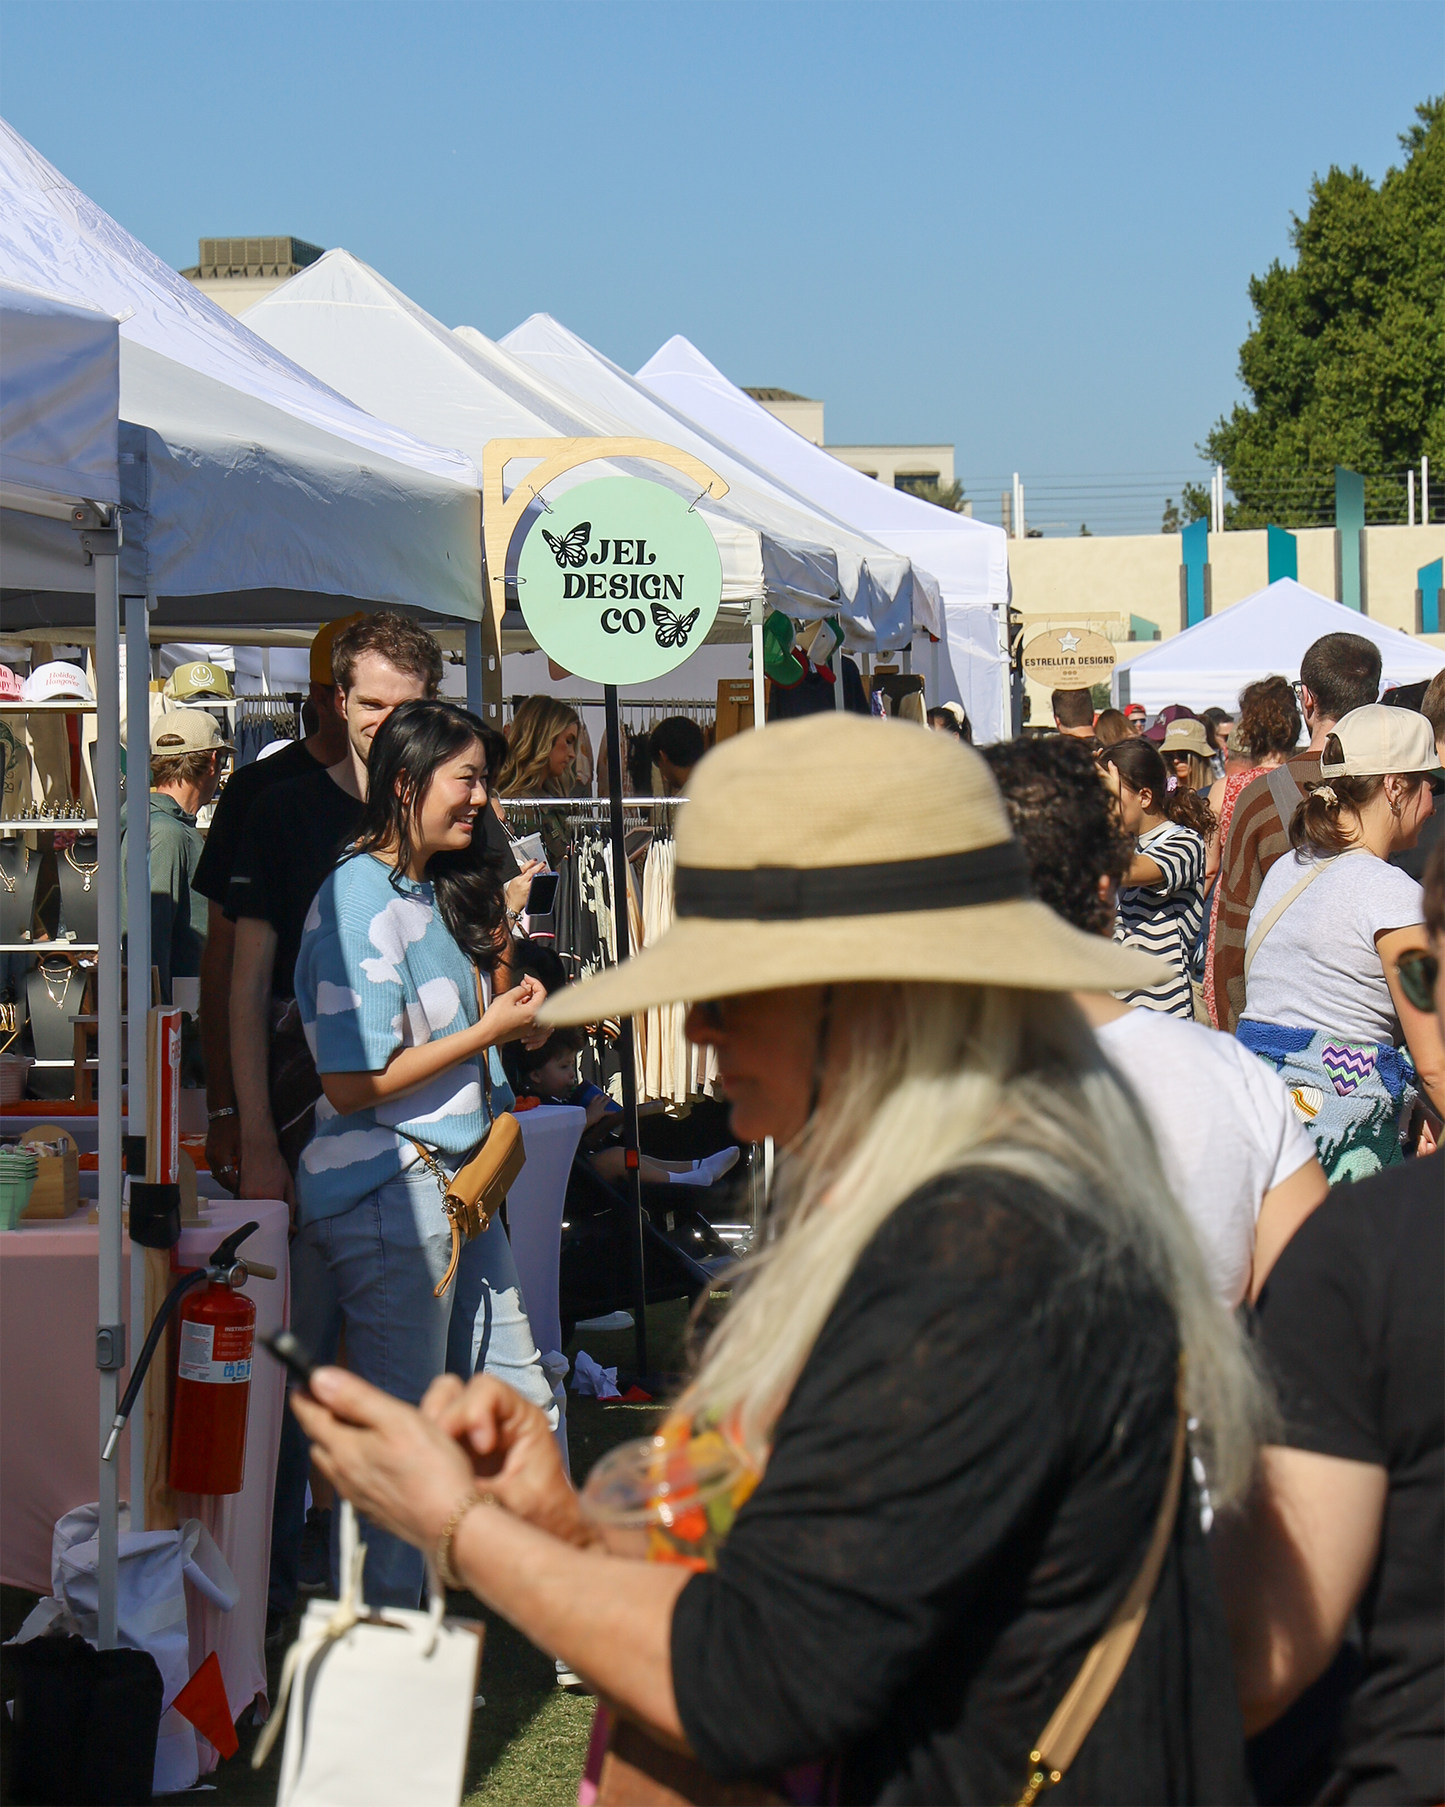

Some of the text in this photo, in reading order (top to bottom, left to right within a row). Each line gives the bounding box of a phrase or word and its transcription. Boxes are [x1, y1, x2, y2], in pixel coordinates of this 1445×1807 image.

[590, 539, 657, 566] JEL
[562, 573, 685, 600] DESIGN
[600, 607, 646, 635] CO
[1025, 656, 1115, 666] ESTRELLITA DESIGNS
[45, 679, 80, 688] Hangover
[49, 672, 77, 680] Holiday
